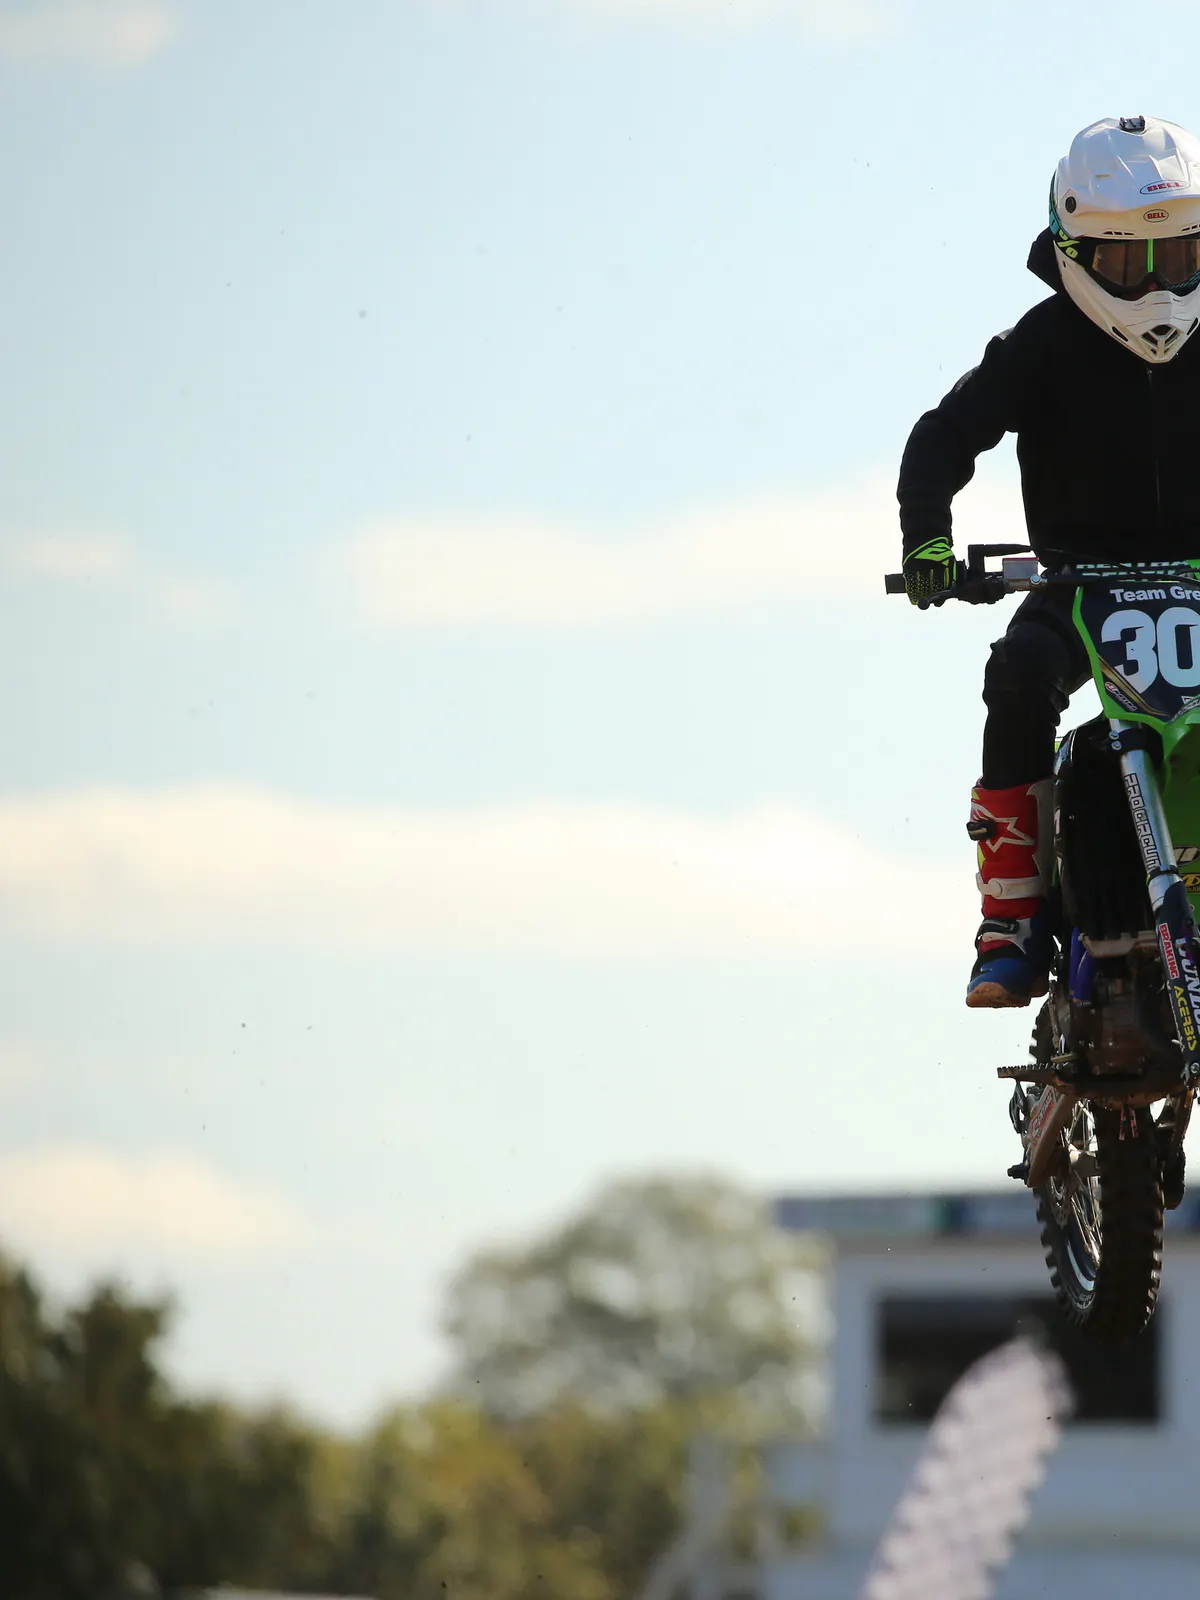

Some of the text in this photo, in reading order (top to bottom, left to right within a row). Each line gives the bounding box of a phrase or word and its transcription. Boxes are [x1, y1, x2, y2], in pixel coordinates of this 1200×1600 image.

[1147, 182, 1184, 192] BELL
[1110, 588, 1167, 603] Team
[1160, 923, 1180, 979] BRAKING
